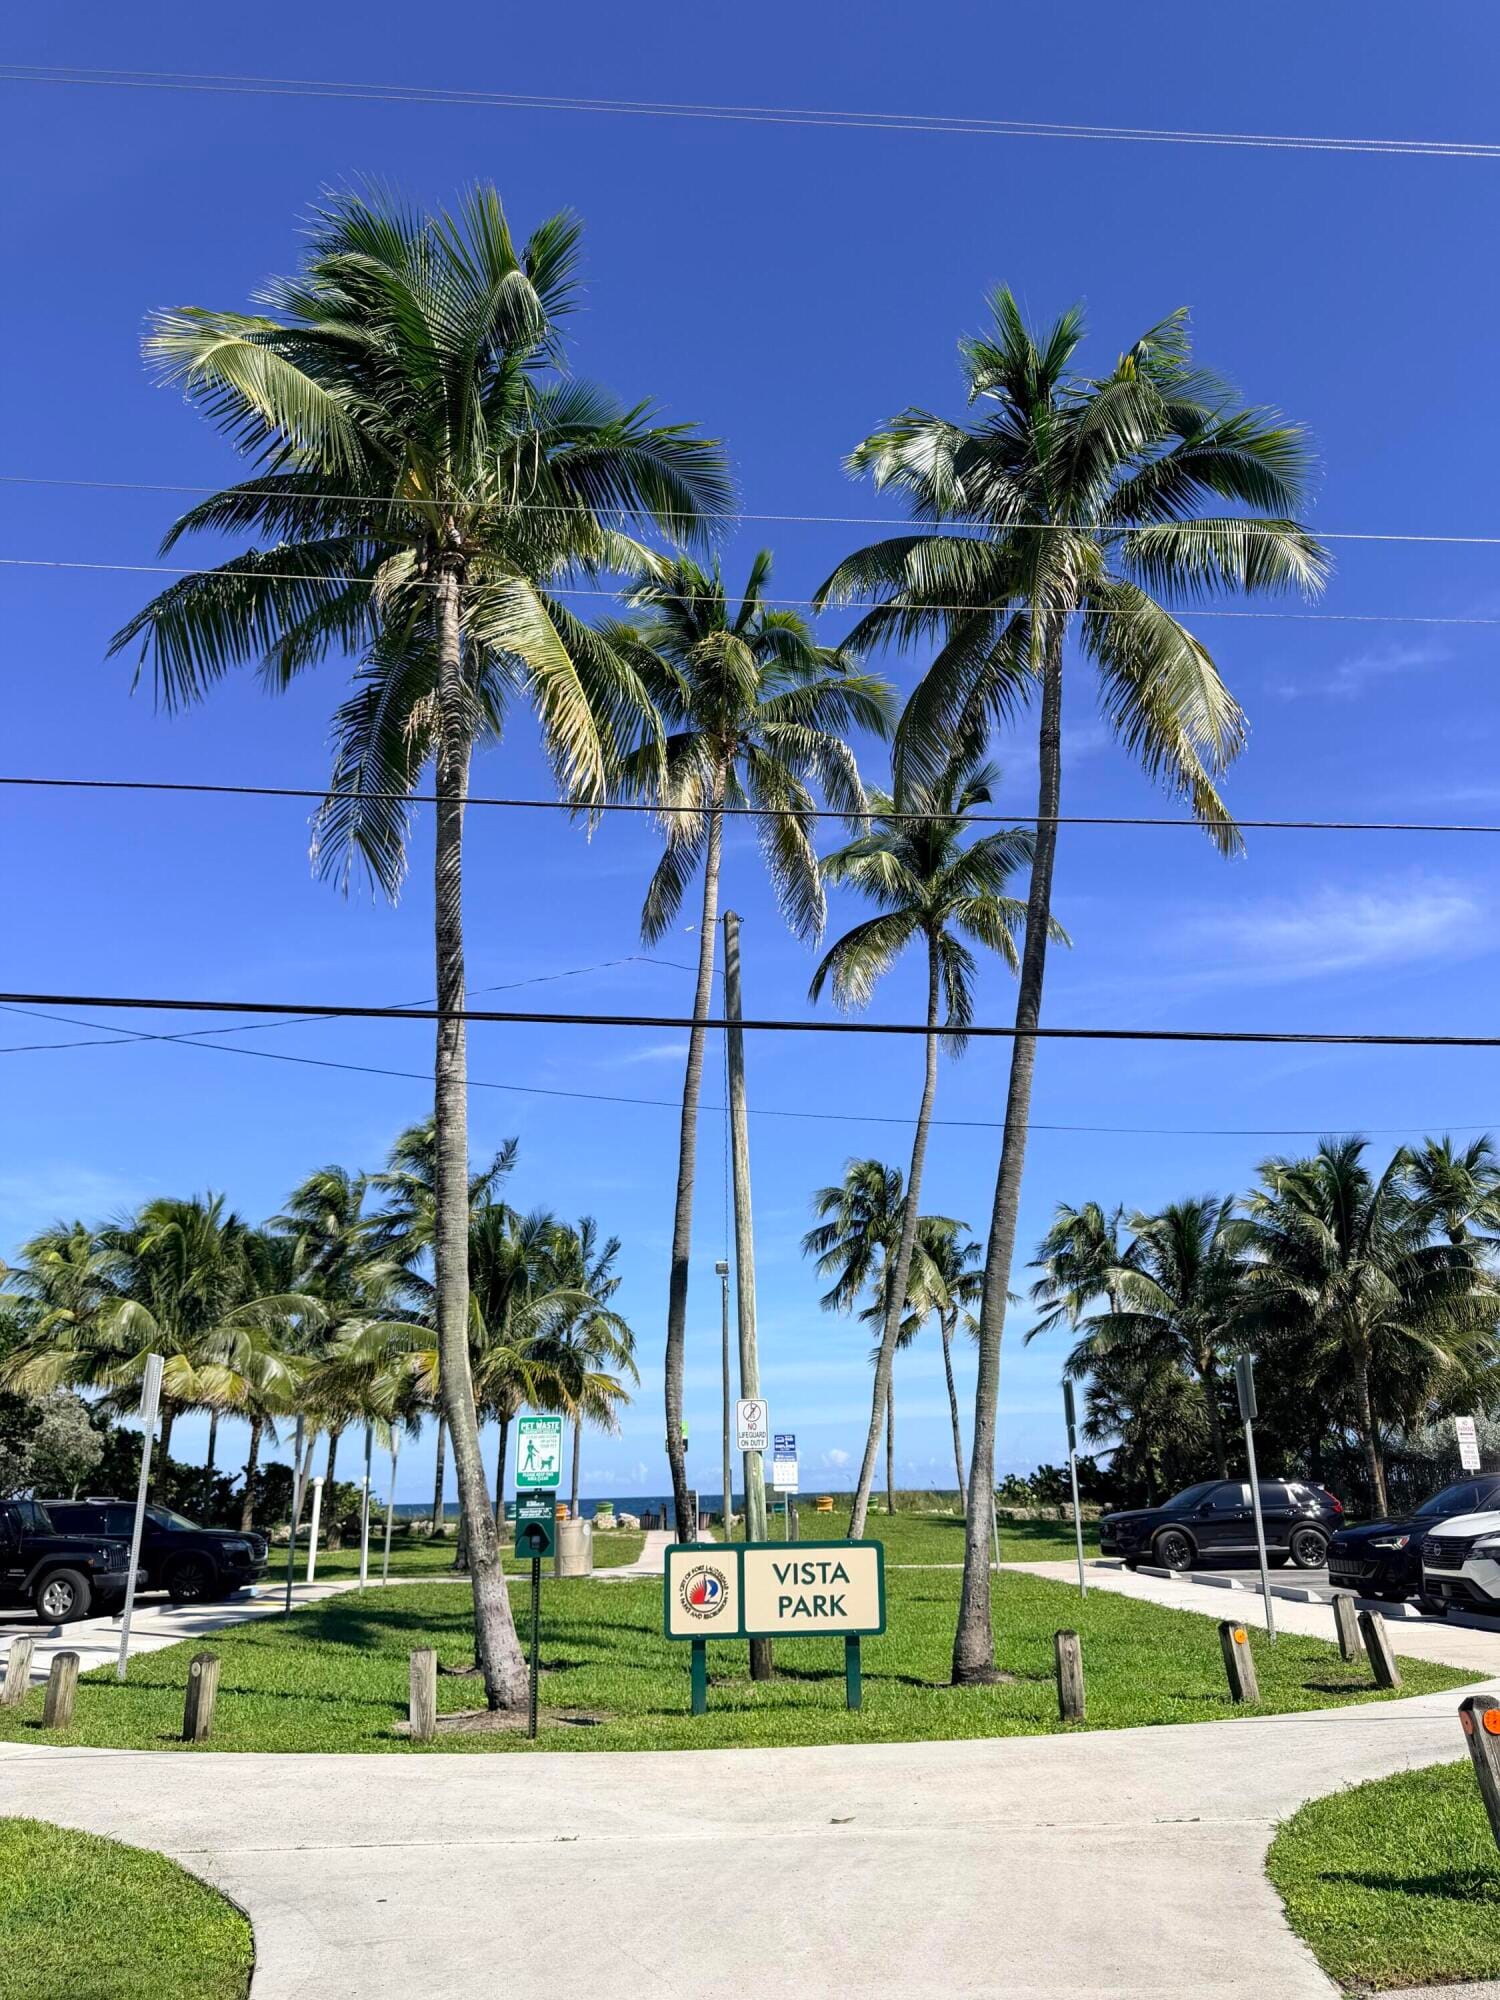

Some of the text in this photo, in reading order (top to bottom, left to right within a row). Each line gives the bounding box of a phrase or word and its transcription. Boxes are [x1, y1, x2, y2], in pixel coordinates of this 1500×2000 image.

[521, 1422, 560, 1431] PET WASTE
[748, 1422, 757, 1431] NO
[772, 1561, 850, 1585] VISTA
[779, 1594, 848, 1618] PARK
